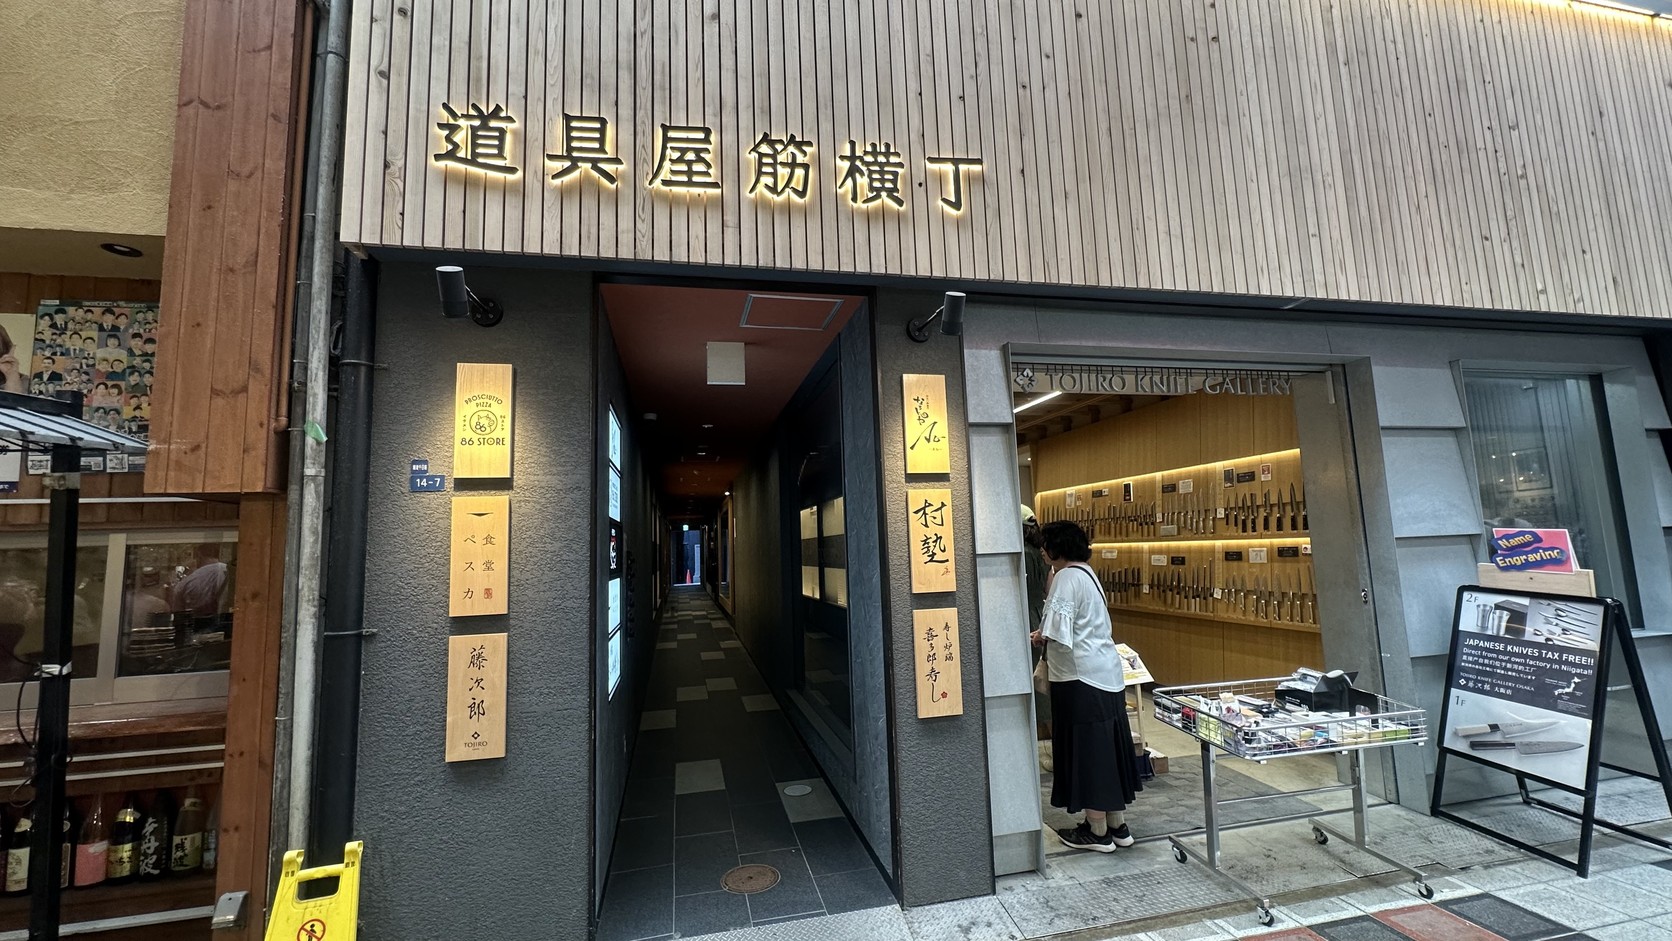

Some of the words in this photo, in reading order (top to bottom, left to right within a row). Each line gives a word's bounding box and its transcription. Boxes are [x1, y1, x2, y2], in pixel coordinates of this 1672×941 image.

[434, 102, 984, 212] 道具屋筋横丁
[1049, 372, 1127, 393] TOJIRO
[1202, 376, 1293, 396] GALLERY
[464, 393, 503, 405] PROSCIUTTO
[475, 421, 486, 432] 86
[460, 437, 474, 446] 86
[477, 437, 505, 446] STORE
[416, 478, 440, 487] 14-7
[1497, 534, 1534, 548] Name
[482, 533, 496, 572] 食堂
[463, 534, 476, 600] ペスカ
[1463, 647, 1481, 656] Direct
[1482, 650, 1497, 659] from
[1511, 656, 1525, 664] own
[1526, 658, 1551, 669] factory
[1464, 638, 1506, 651] JAPANESE
[1507, 644, 1539, 656] KNIVES
[1541, 650, 1560, 660] TAX
[1562, 653, 1594, 666] FREE!!
[467, 645, 488, 722] 藤次郎
[1493, 679, 1516, 688] GALLERY
[464, 740, 488, 748] TOJIRO
